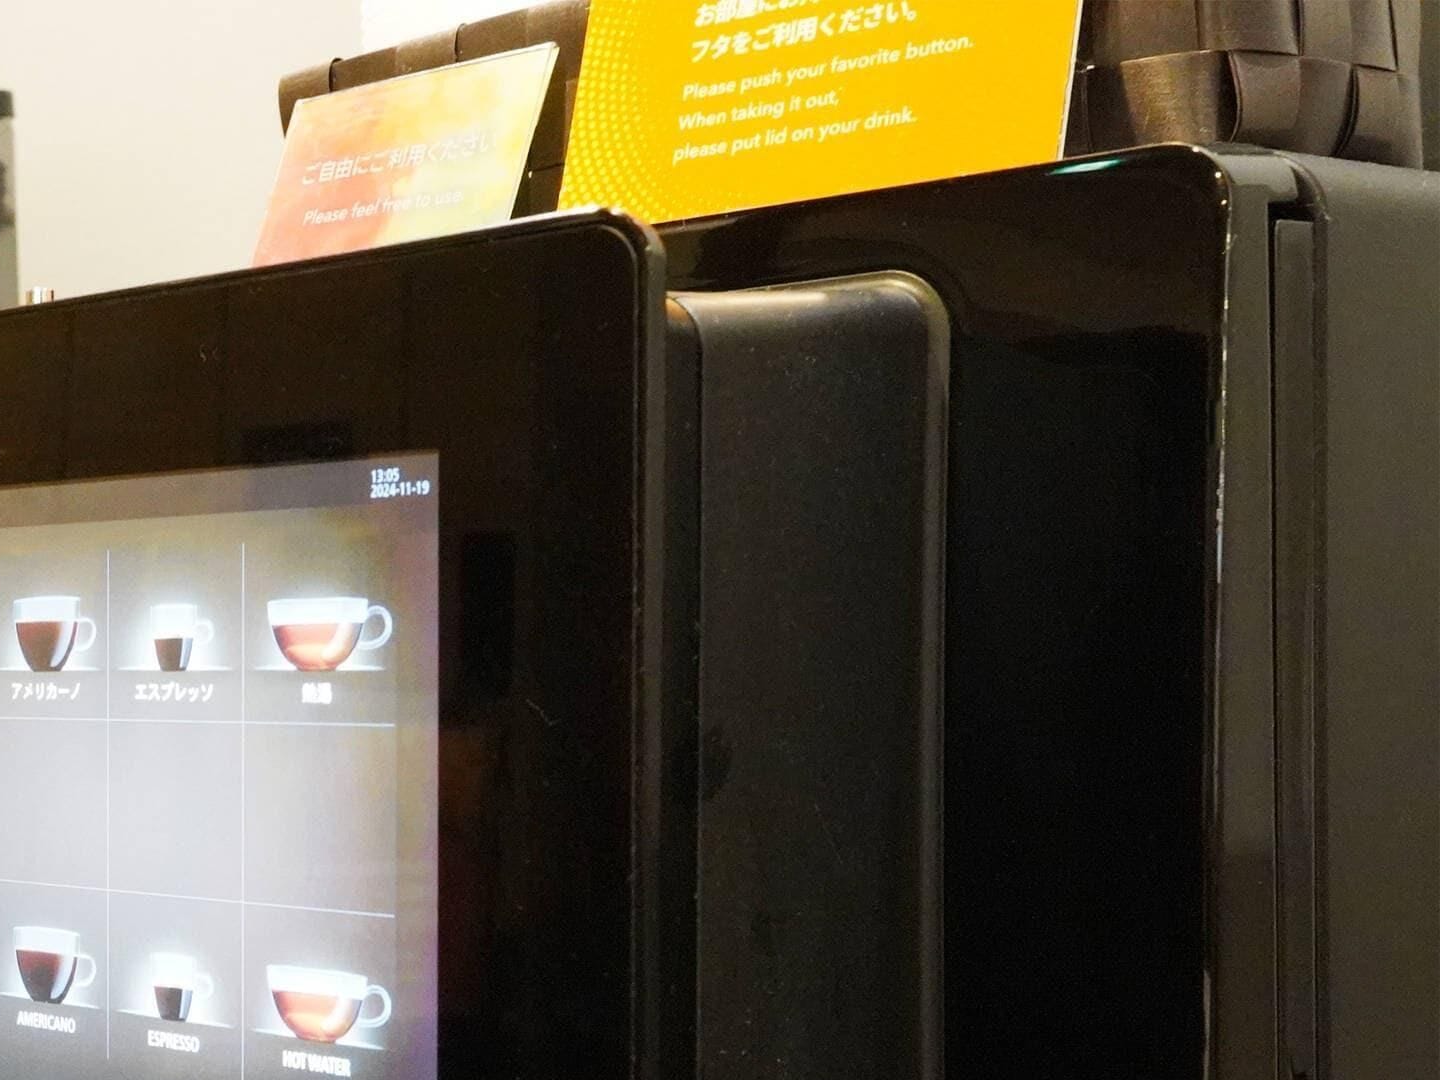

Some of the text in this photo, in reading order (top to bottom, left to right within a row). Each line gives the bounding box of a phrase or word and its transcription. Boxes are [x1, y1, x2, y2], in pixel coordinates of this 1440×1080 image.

[691, 1, 918, 63] フタをご利用ください。
[681, 34, 975, 101] Please push your favorite button.
[678, 88, 840, 131] When taking it out,
[671, 103, 918, 166] please put lid on your drink.
[302, 207, 348, 226] Please
[351, 200, 380, 219] feel
[381, 194, 411, 214] free
[415, 191, 432, 208] to
[370, 466, 401, 484] 13:05
[369, 479, 431, 499] 2024-11-19
[10, 680, 81, 702] アメリカーノ
[134, 681, 215, 703] エスプレッソ
[16, 1009, 77, 1035] AMERICANO
[146, 1028, 201, 1054] ESPRESSO
[281, 1049, 352, 1078] HOT WATER
